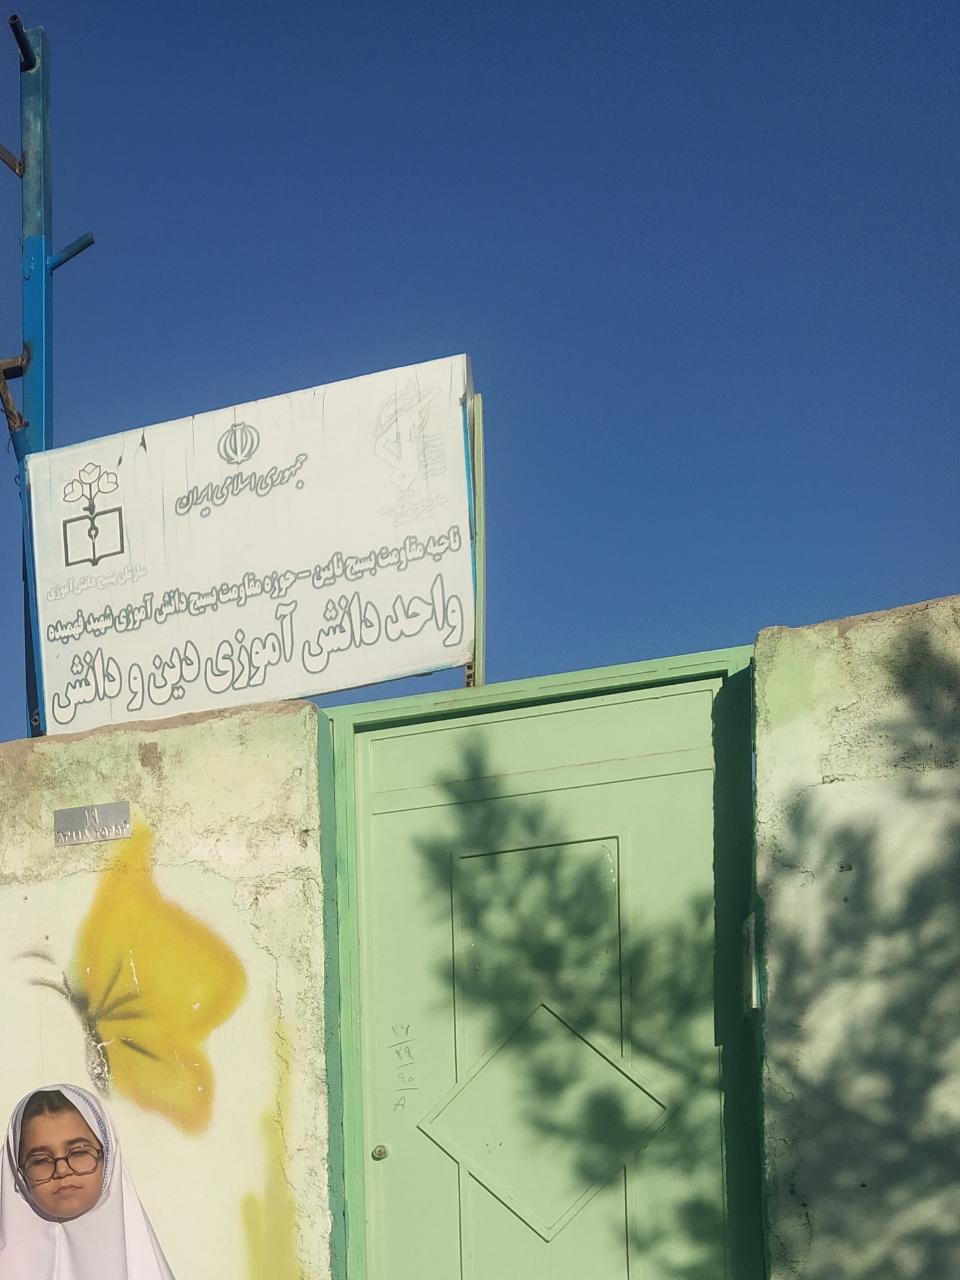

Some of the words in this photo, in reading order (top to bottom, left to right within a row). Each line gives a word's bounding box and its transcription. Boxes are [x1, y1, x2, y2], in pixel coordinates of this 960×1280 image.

[212, 472, 257, 507] اسلامی
[256, 453, 309, 498] جمهوری
[174, 482, 214, 519] ایران
[376, 535, 426, 571] مقاومت
[425, 525, 462, 562] ناحیه
[263, 569, 297, 599] حوزه
[312, 551, 344, 589] نایین
[344, 550, 377, 581] بسیج
[154, 588, 189, 623] دانش
[188, 586, 218, 616] بسیج
[217, 572, 264, 606] مقاومت
[46, 609, 86, 645] فهمیده
[85, 604, 114, 638] شهید
[114, 592, 154, 634] آموزی
[384, 573, 464, 647] واحد
[204, 600, 298, 694] آموزی
[301, 591, 381, 674] دانش
[52, 647, 123, 725] دانش
[126, 662, 145, 712] و
[147, 640, 202, 706] دین
